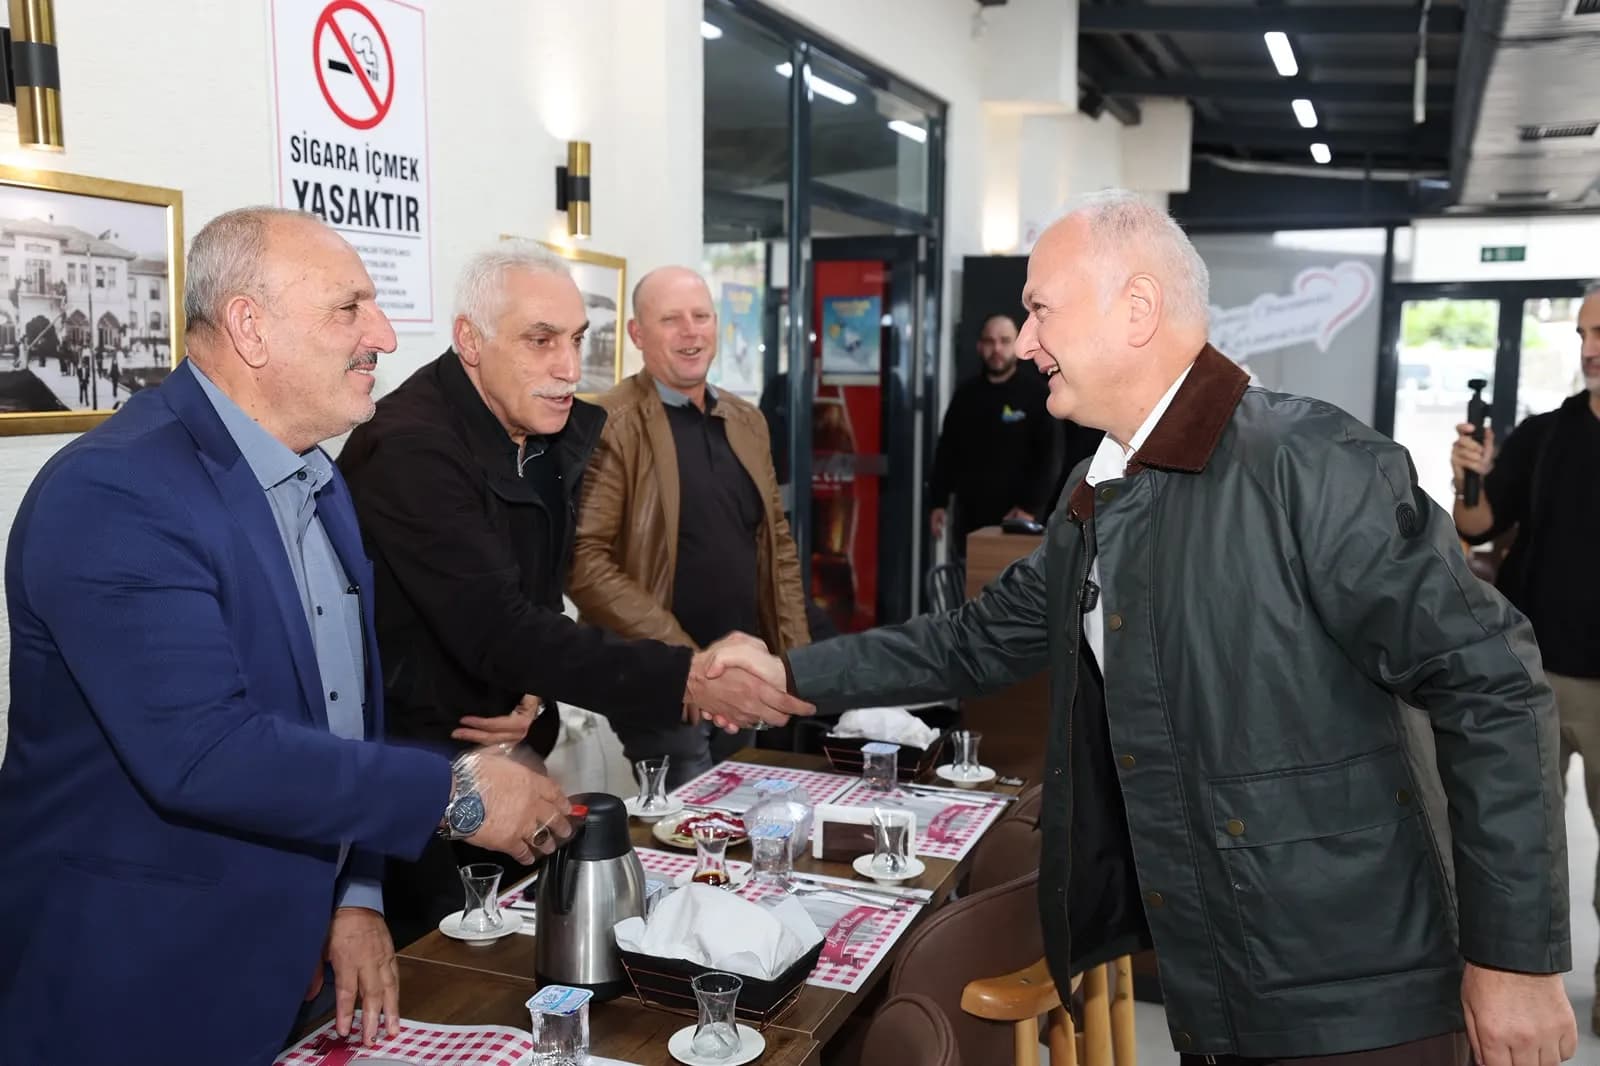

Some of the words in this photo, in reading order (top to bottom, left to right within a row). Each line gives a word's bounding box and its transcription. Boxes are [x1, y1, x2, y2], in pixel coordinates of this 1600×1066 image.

[290, 130, 359, 173] SİGARA
[365, 143, 420, 183] İÇMEK
[292, 178, 420, 233] YASAKTIR
